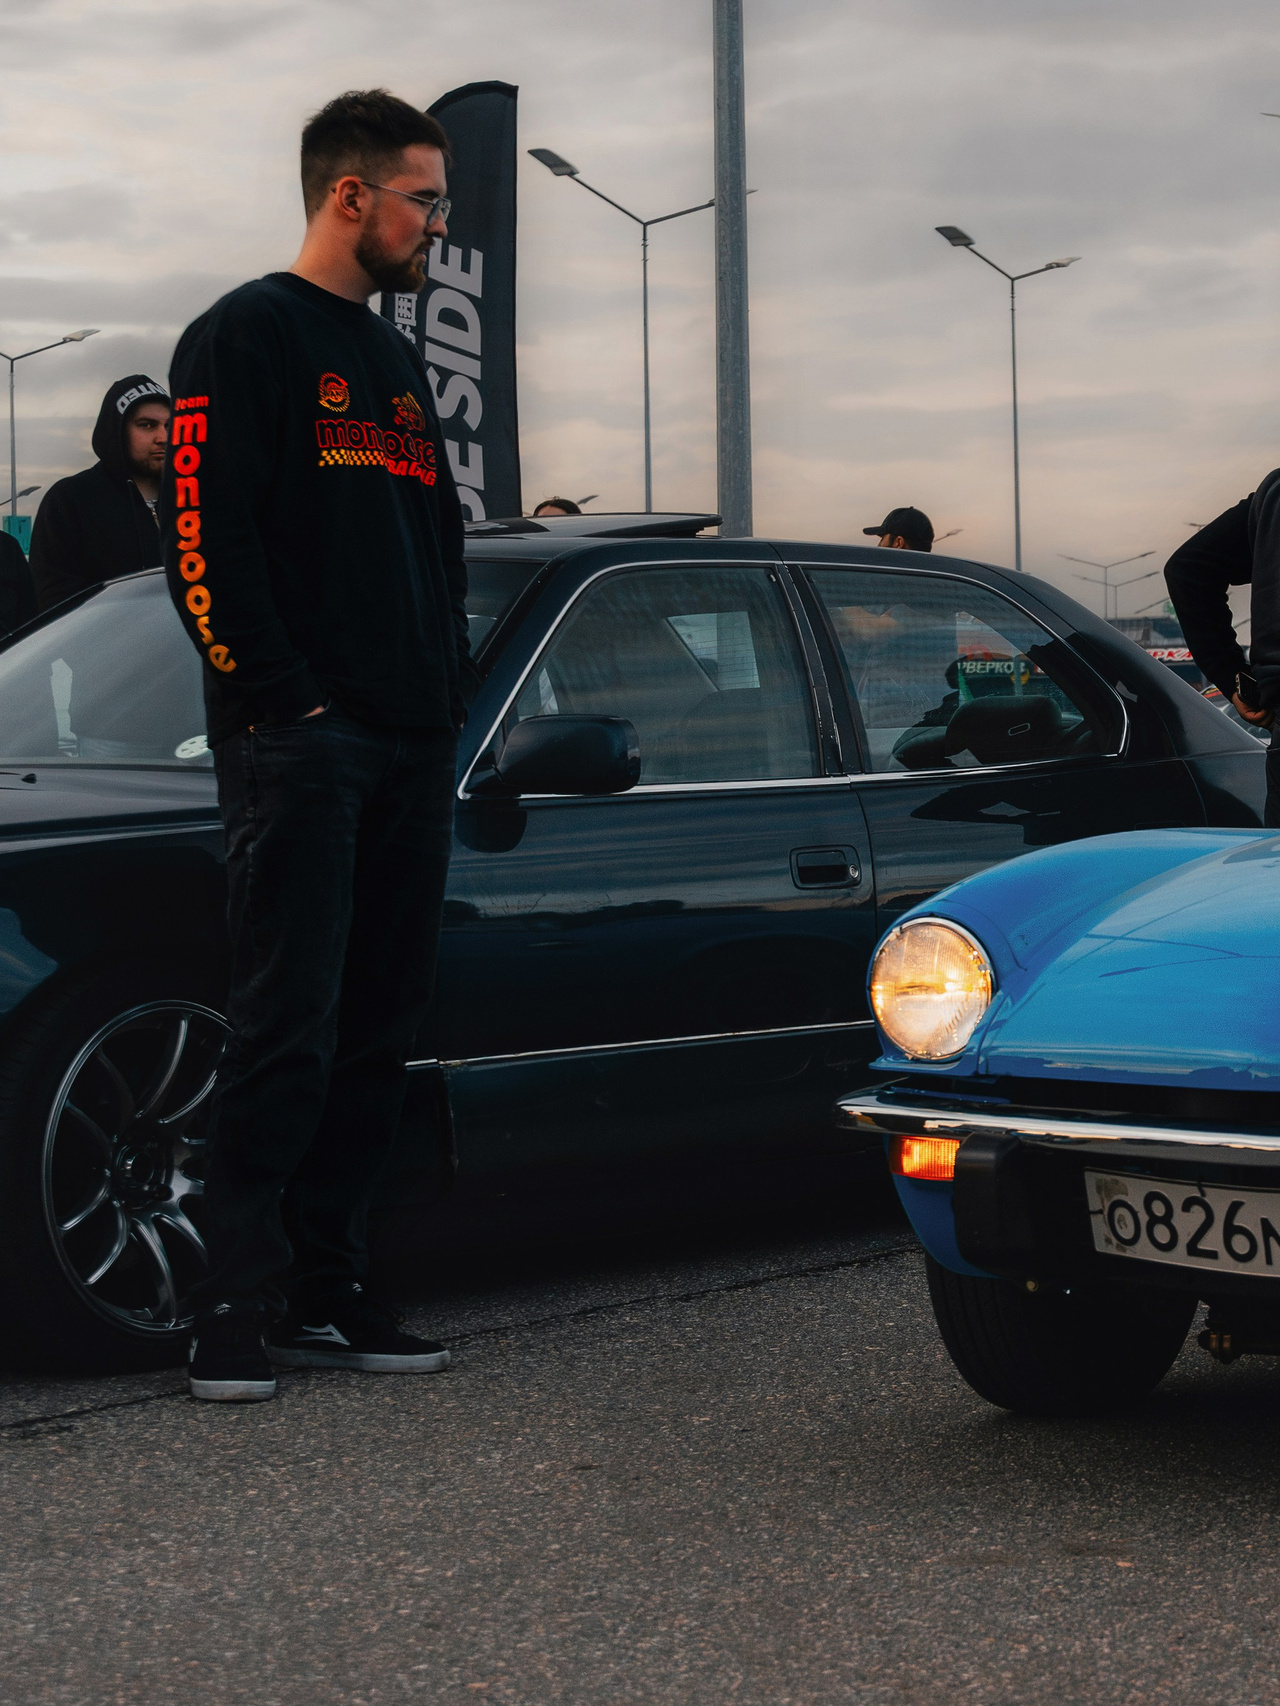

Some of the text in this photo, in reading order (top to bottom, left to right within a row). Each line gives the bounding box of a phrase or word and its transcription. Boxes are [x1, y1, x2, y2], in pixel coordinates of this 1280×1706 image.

[116, 382, 168, 415] NTED
[385, 459, 437, 487] RACNG
[171, 412, 237, 673] mongoose
[1146, 649, 1194, 660] РКА
